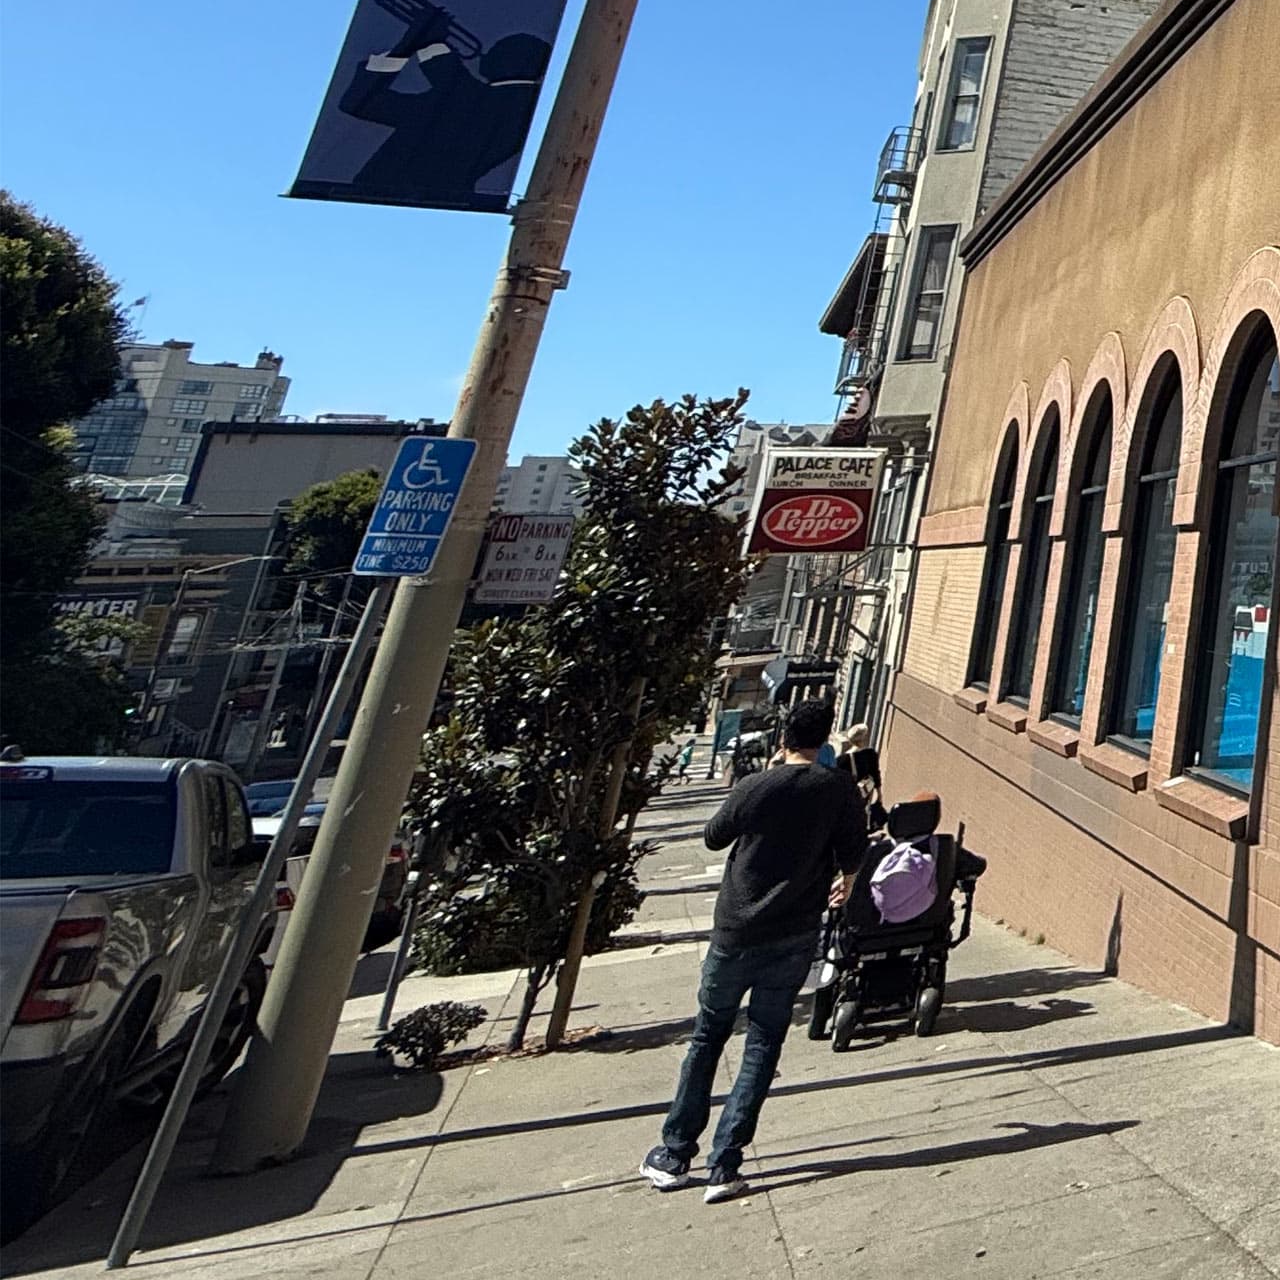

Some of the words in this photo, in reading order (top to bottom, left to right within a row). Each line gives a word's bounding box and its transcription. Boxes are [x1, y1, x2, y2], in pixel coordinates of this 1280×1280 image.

[772, 456, 835, 478] PALACE
[838, 457, 875, 478] CAFE
[794, 472, 849, 480] BREAKFAST
[772, 480, 804, 488] LUNCH
[828, 480, 868, 488] DINNER
[381, 490, 454, 511] PARKING
[806, 499, 843, 519] Dr
[384, 512, 433, 533] ONLY
[495, 517, 521, 541] NO
[521, 522, 571, 540] PARKING
[771, 508, 857, 539] Pepper
[371, 537, 428, 553] MINIMUM
[357, 553, 385, 569] FINE
[391, 555, 430, 570] $250
